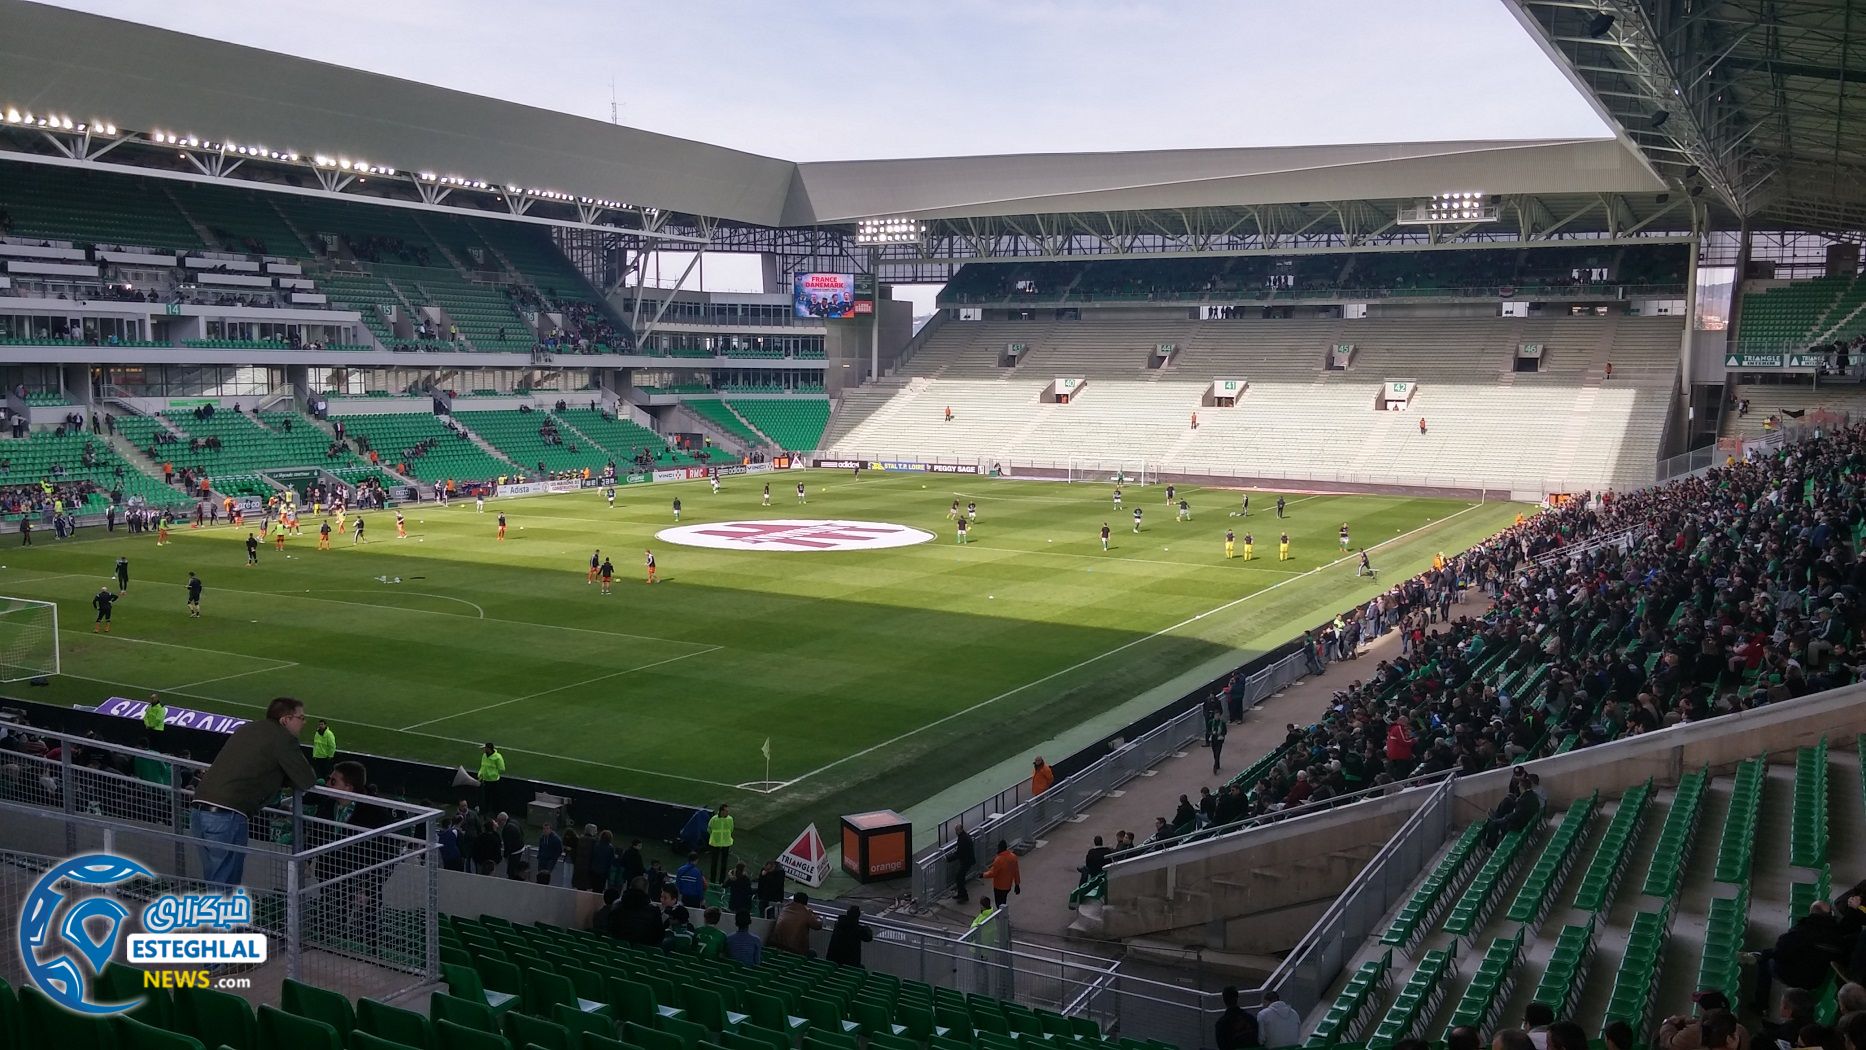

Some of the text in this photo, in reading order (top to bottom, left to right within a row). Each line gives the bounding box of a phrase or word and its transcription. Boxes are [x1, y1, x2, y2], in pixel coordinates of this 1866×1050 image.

[168, 304, 179, 315] 14
[382, 306, 391, 315] 15
[1162, 344, 1171, 352] 44
[1065, 379, 1075, 387] 40
[689, 467, 704, 478] RMC
[934, 464, 976, 473] PEGGY SAGE
[510, 486, 530, 495] Adista
[781, 854, 815, 874] TRIANGLE
[870, 861, 902, 873] orange
[697, 942, 708, 954] 7
